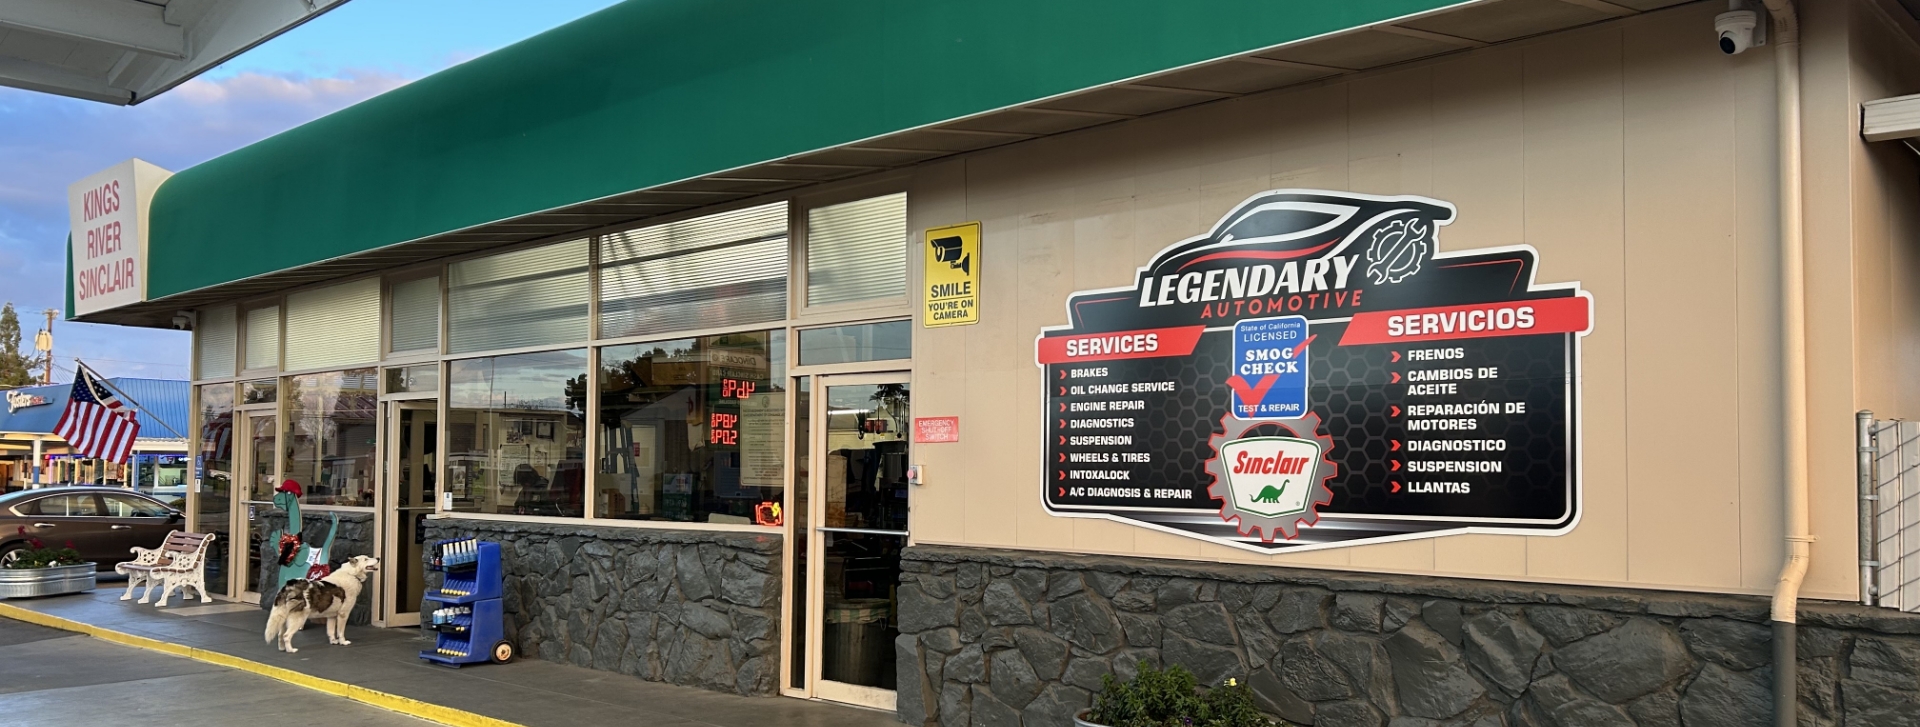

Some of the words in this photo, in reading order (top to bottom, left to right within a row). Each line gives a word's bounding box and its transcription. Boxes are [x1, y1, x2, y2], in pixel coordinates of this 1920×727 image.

[84, 180, 120, 222] KINGS
[87, 221, 121, 260] RIVER
[79, 257, 134, 300] SINCLAIR
[1139, 254, 1360, 307] LEGENDARY
[931, 281, 971, 298] SMILE
[928, 301, 958, 311] YOU'RE
[961, 299, 974, 309] ON
[1201, 289, 1363, 319] AUTOMOTIVE
[933, 309, 968, 320] CAMERA
[1387, 306, 1535, 336] SERVICIOS
[1268, 322, 1300, 330] California
[1243, 330, 1297, 342] LICENSED
[1066, 333, 1158, 357] SERVICES
[1245, 347, 1294, 361] SMOG
[1408, 348, 1464, 361] FRENOS
[1070, 367, 1108, 379] BRAKES
[1240, 361, 1299, 375] CHECK
[1408, 368, 1473, 382] CAMBIOS
[1478, 367, 1498, 379] DE
[1070, 385, 1086, 395] OIL
[1088, 383, 1129, 394] CHANGE
[1131, 381, 1175, 393] SERVICE
[1407, 383, 1457, 396] ACEITE
[1070, 401, 1107, 412] ENGINE
[1109, 400, 1145, 411] REPAIR
[1238, 404, 1259, 413] TEST
[1260, 404, 1267, 412] &
[1268, 403, 1299, 412] REPAIR
[1408, 400, 1499, 416] REPARACIÓN
[1505, 402, 1526, 414] DE
[918, 419, 954, 427] EMERGENCY
[1070, 418, 1134, 429] DIAGNOSTICS
[1408, 418, 1477, 431] MOTORES
[1070, 435, 1132, 446] SUSPENSION
[1408, 439, 1507, 451] DIAGNOSTICO
[1070, 453, 1109, 463] WHEELS
[1111, 453, 1119, 463] &
[1121, 453, 1150, 463] TIRES
[1233, 450, 1310, 475] Sinclair
[1407, 461, 1502, 473] SUSPENSION
[1069, 470, 1130, 480] INTOXALOCK
[1069, 487, 1085, 497] A/C
[1087, 487, 1141, 498] DIAGNOSIS
[1143, 488, 1151, 498] &
[1154, 488, 1192, 500] REPAIR
[1408, 481, 1471, 494] LLANTAS
